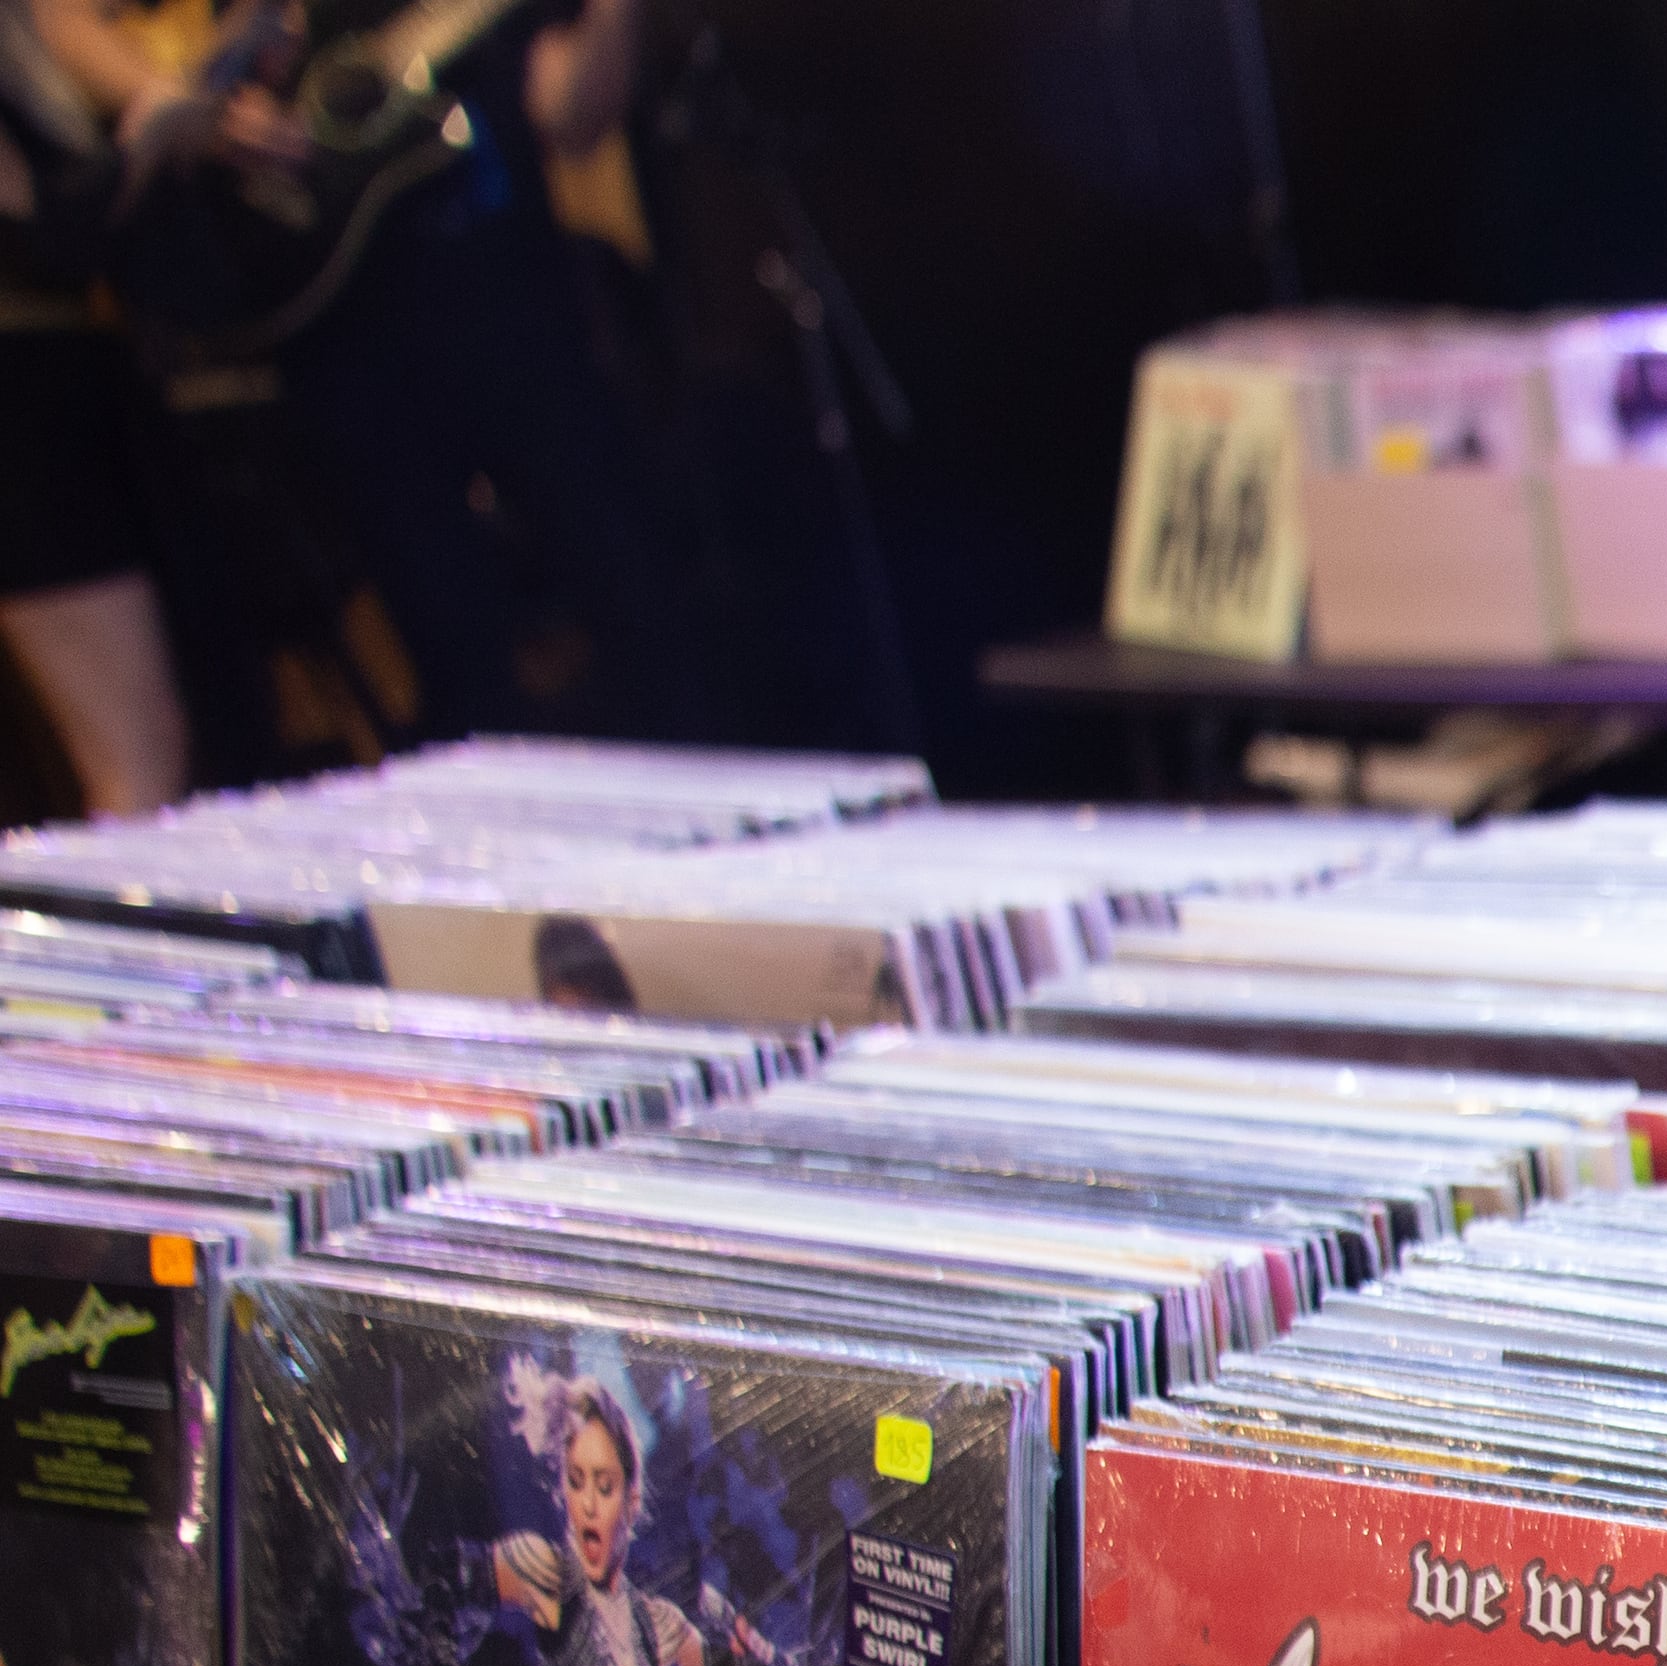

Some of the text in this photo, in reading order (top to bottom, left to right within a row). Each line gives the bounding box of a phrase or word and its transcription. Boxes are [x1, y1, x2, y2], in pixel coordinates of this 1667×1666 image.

[852, 1534, 954, 1583] FIRST TIME
[852, 1555, 880, 1579] ON
[1410, 1544, 1507, 1630] we
[853, 1605, 944, 1657] PURPLE
